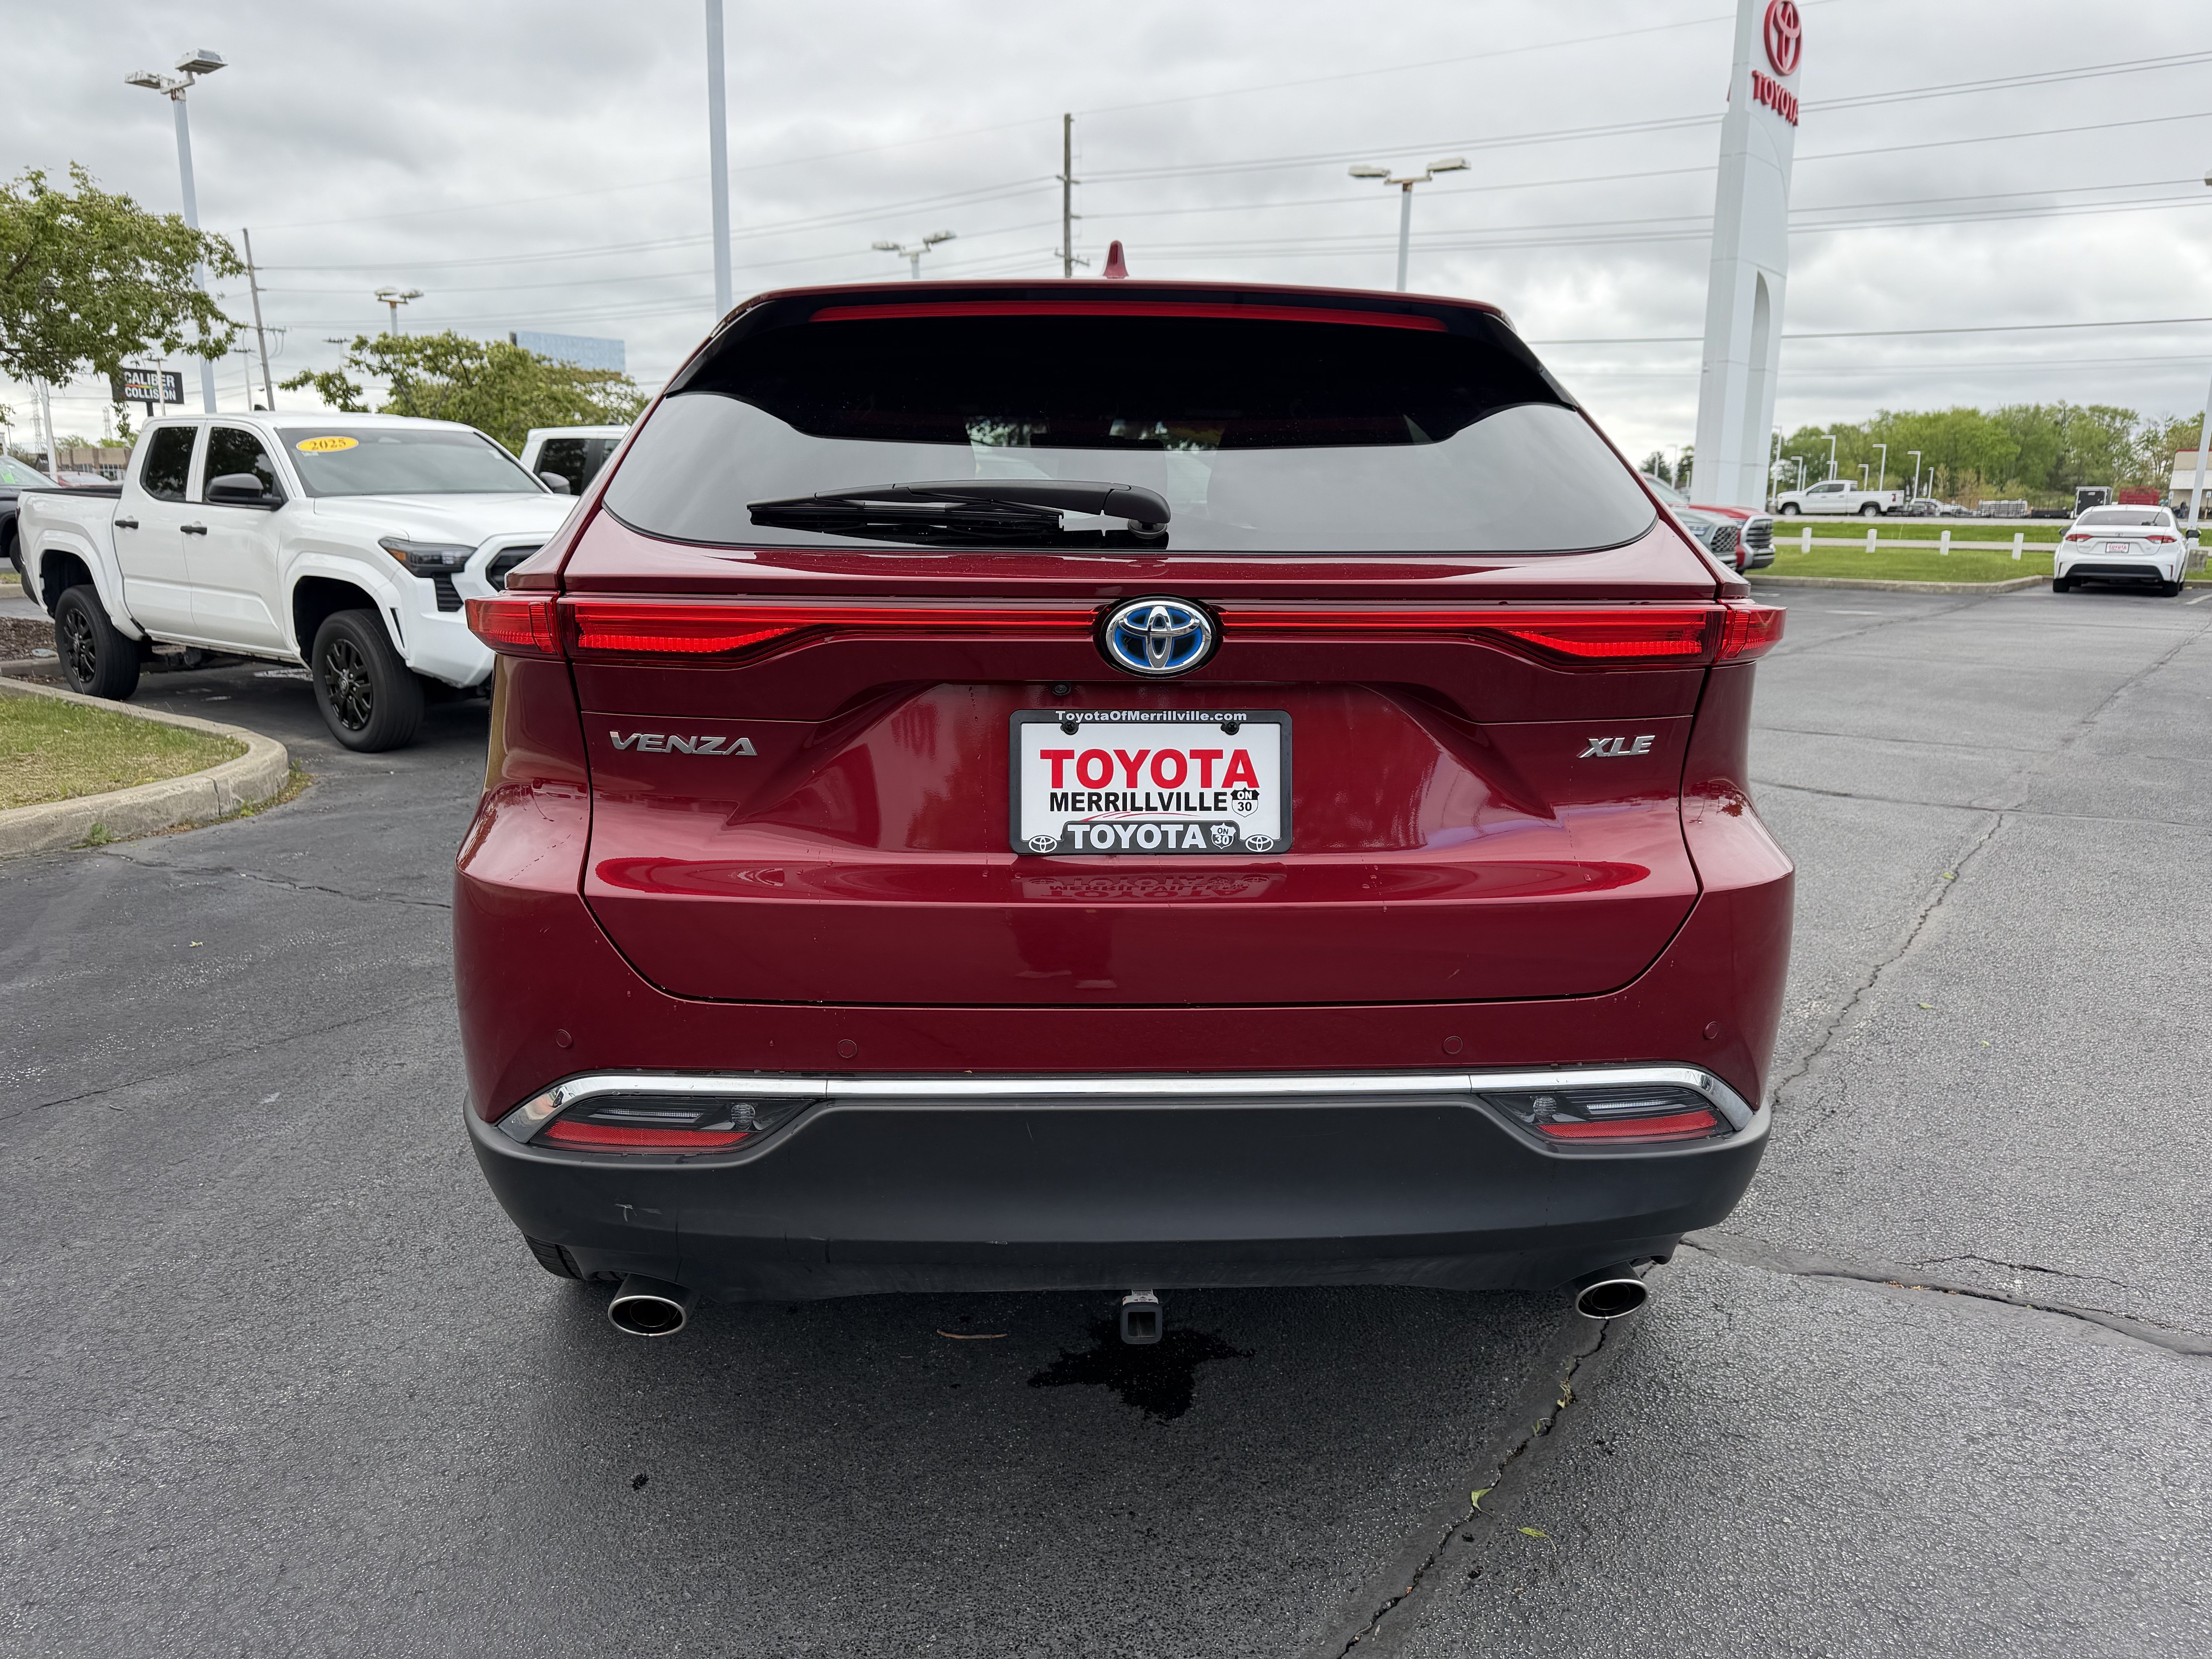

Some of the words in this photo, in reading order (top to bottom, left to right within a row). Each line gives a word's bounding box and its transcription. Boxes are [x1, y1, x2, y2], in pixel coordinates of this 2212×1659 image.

[1752, 70, 1798, 126] TOYOTA
[125, 387, 176, 400] COLLISON
[310, 438, 346, 451] 2025
[1056, 711, 1247, 723] ToyotaOfMerrillville.com
[610, 731, 757, 756] VENZA
[1577, 735, 1655, 758] XLE
[1040, 749, 1260, 788] TOYOTA
[1050, 792, 1228, 811] MERRILLVILLE
[1237, 791, 1252, 800] ON
[1237, 802, 1252, 811] 30
[1067, 824, 1207, 849] TOYOTA
[1214, 835, 1230, 845] 30
